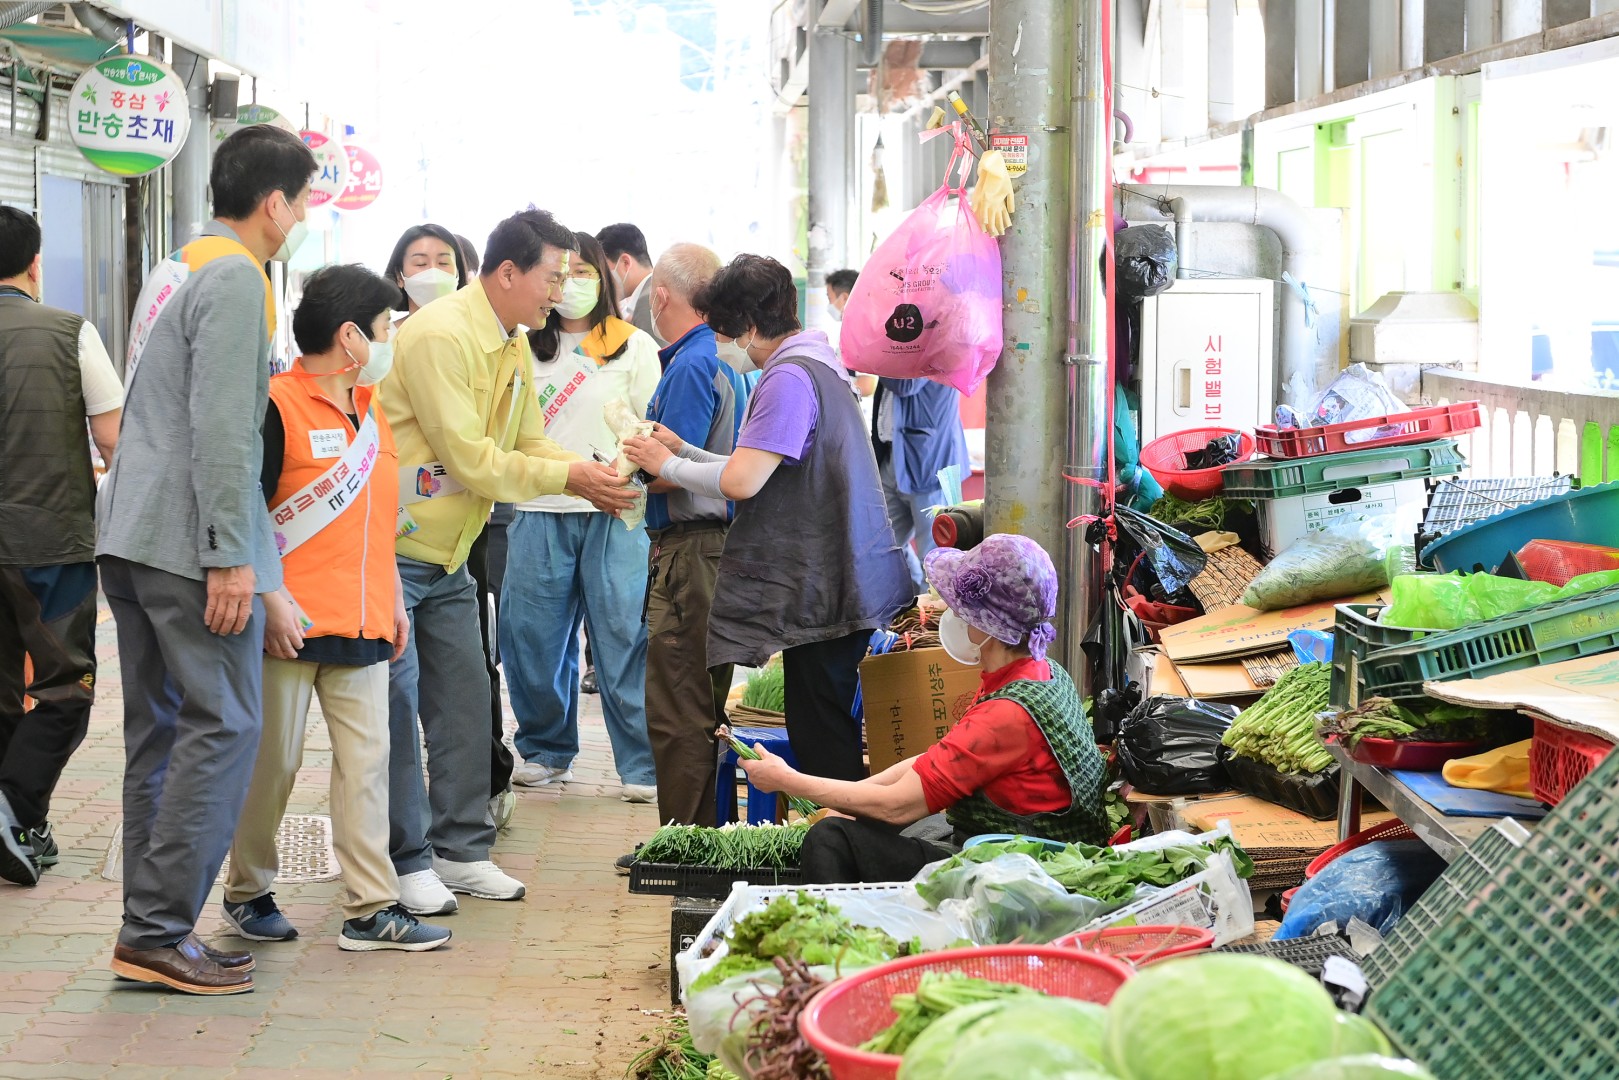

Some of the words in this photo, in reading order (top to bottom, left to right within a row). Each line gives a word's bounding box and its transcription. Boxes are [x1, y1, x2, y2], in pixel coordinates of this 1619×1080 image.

[110, 90, 147, 110] 홍삼
[893, 316, 915, 330] U2
[1204, 335, 1222, 428] 시험밸브
[274, 462, 350, 526] 전통시장
[890, 699, 906, 762] 사합니다.
